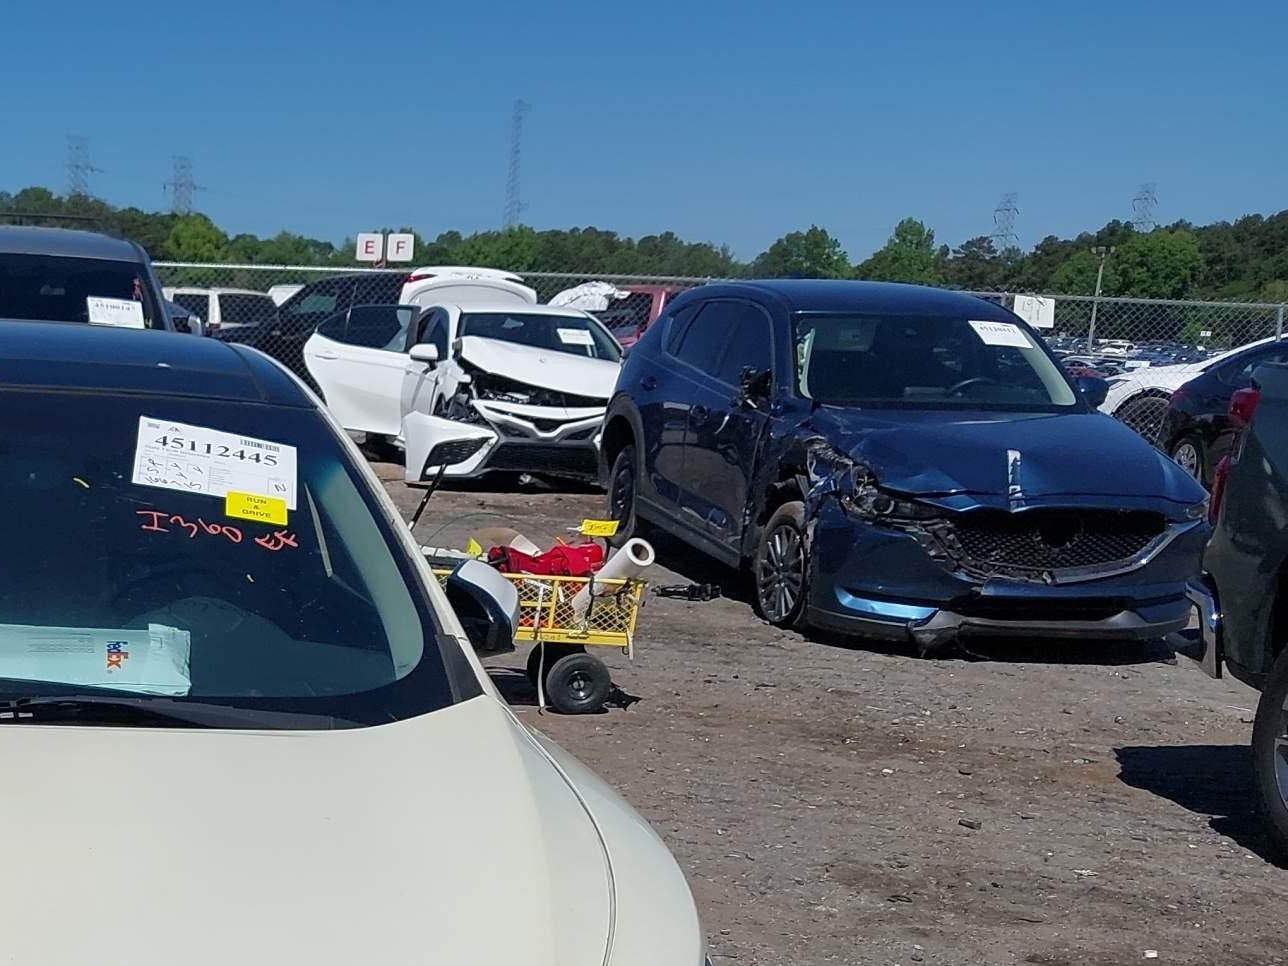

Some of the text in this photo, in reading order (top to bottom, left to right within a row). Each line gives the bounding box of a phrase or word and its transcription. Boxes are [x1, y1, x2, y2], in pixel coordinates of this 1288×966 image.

[364, 240, 375, 254] E
[396, 240, 406, 254] F
[155, 435, 278, 466] 45112445
[246, 497, 267, 505] RUN
[242, 508, 272, 519] DRIVE
[106, 640, 129, 669] FedEx
